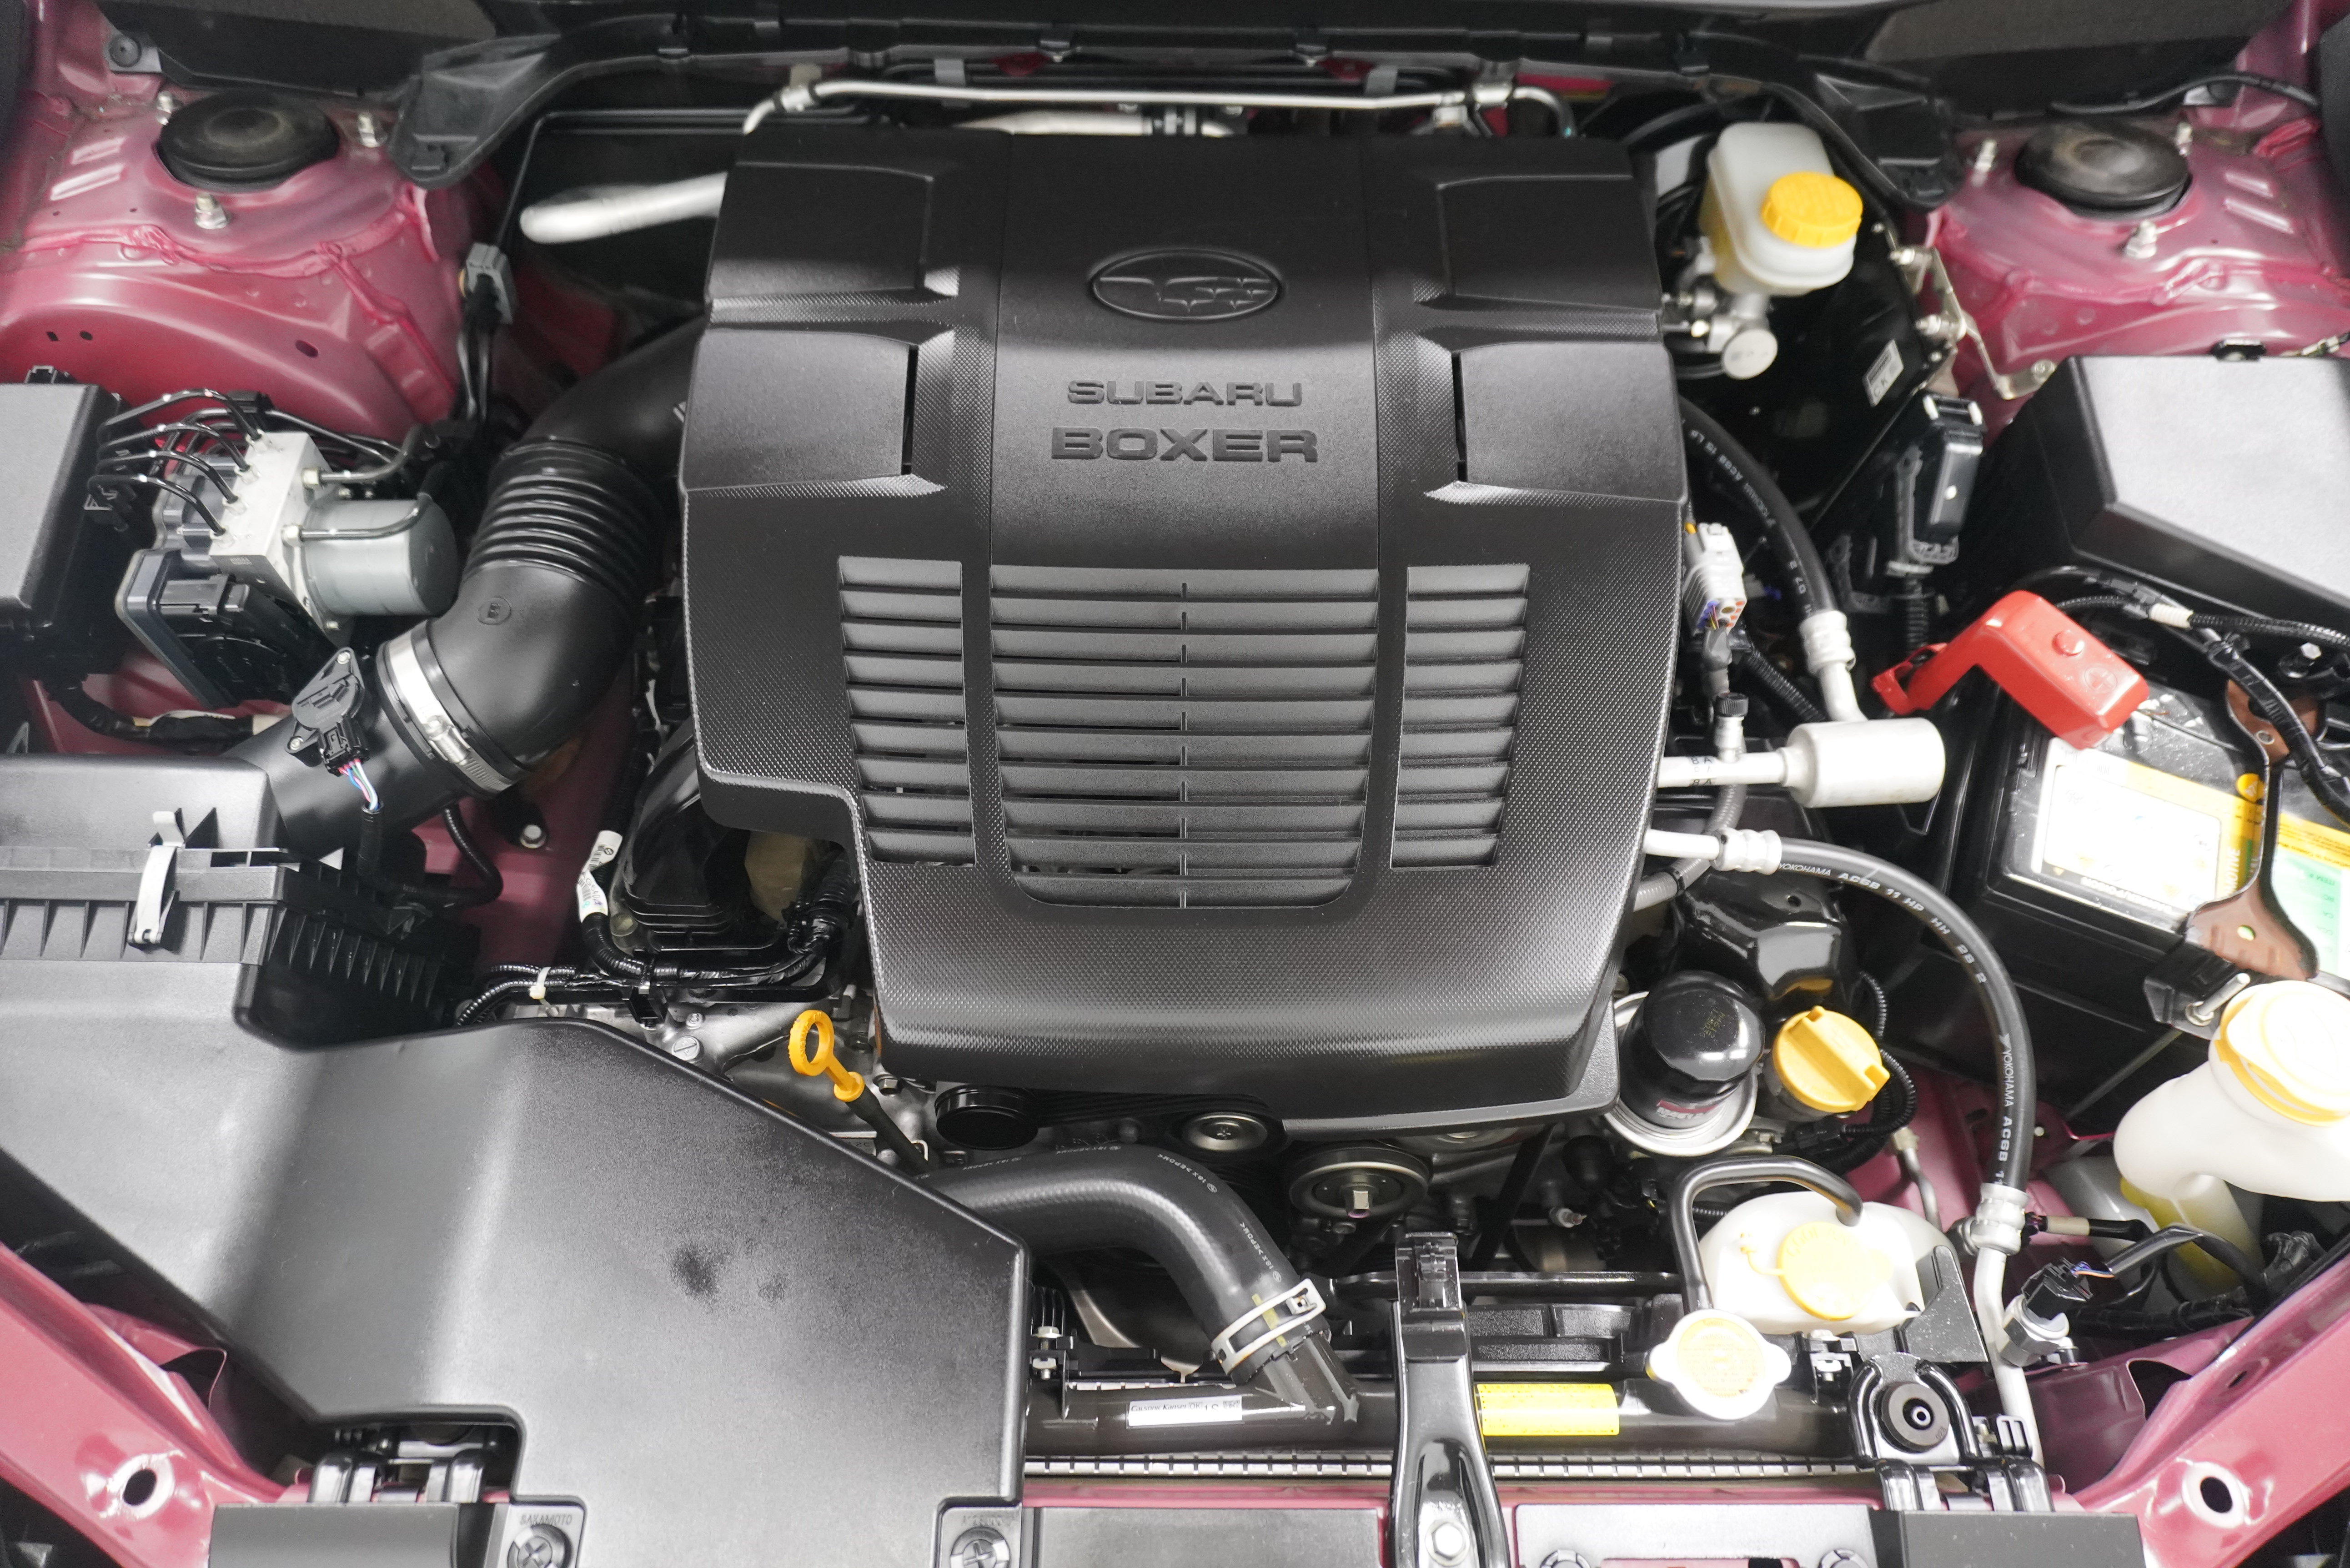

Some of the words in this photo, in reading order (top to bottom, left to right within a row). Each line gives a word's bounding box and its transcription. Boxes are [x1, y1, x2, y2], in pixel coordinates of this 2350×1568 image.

[1067, 380, 1303, 407] SUBARU
[1051, 427, 1319, 462] BOXER
[2080, 876, 2174, 915] DANGER/POISON
[1778, 862, 1832, 877] YOKOHAMA
[1838, 872, 1881, 890] AC6B
[1885, 888, 1902, 899] 11
[1902, 896, 1925, 912] HP
[1930, 917, 1951, 935] HH
[1955, 944, 1975, 964] 28
[1975, 972, 1987, 984] 2
[2002, 1049, 2014, 1107] YOKOHAMA
[1998, 1116, 2013, 1162] AC6B
[520, 1513, 572, 1526] SAKAMOTO
